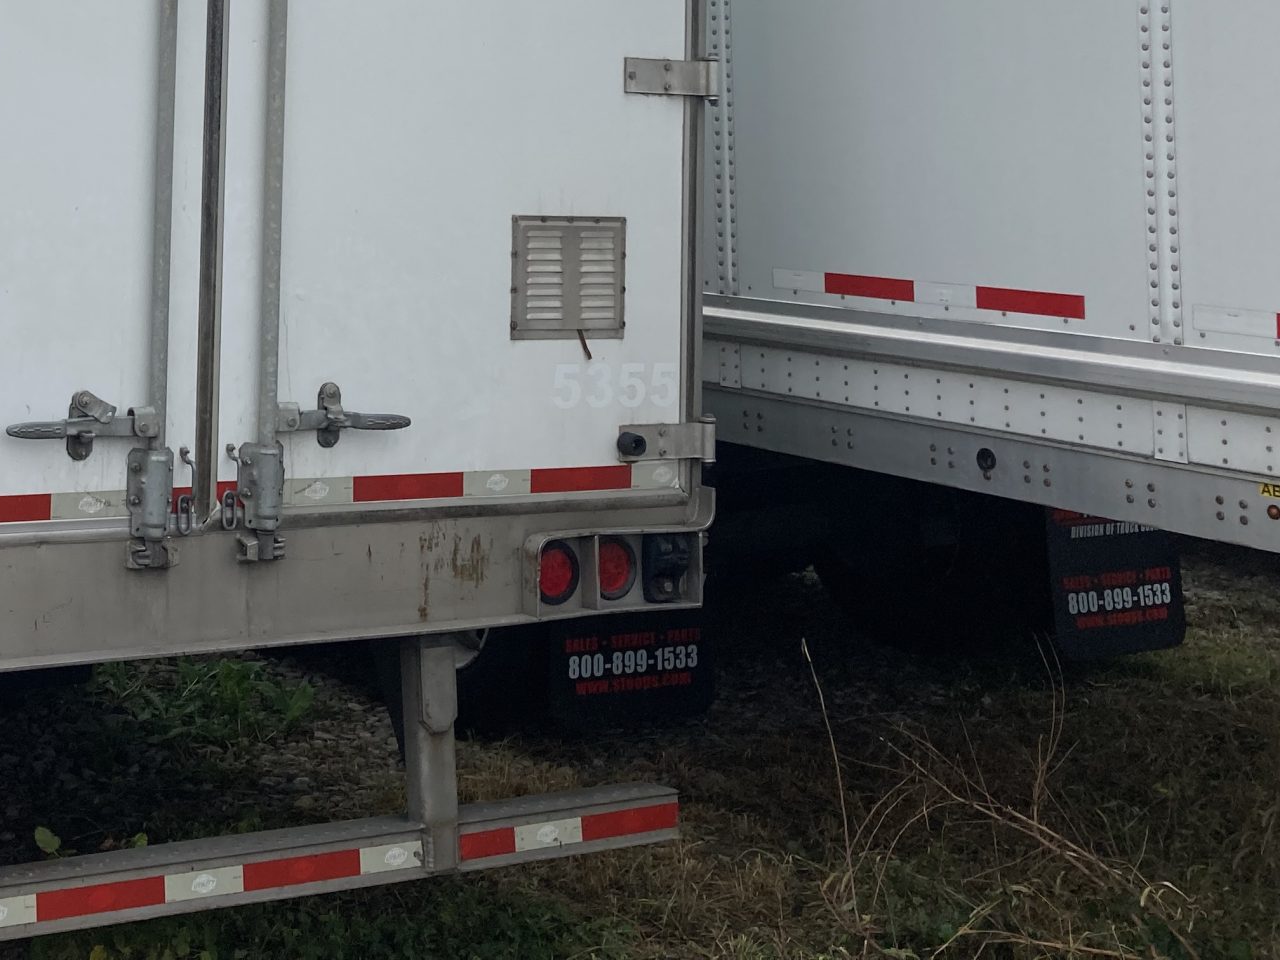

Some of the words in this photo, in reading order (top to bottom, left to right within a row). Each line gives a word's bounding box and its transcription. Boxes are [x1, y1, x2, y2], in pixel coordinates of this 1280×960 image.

[552, 362, 677, 410] 5355
[1070, 524, 1104, 539] DIVISION
[1106, 523, 1115, 536] OF
[1068, 582, 1171, 615] 800-899-1533
[569, 644, 698, 679] 800-899-1533
